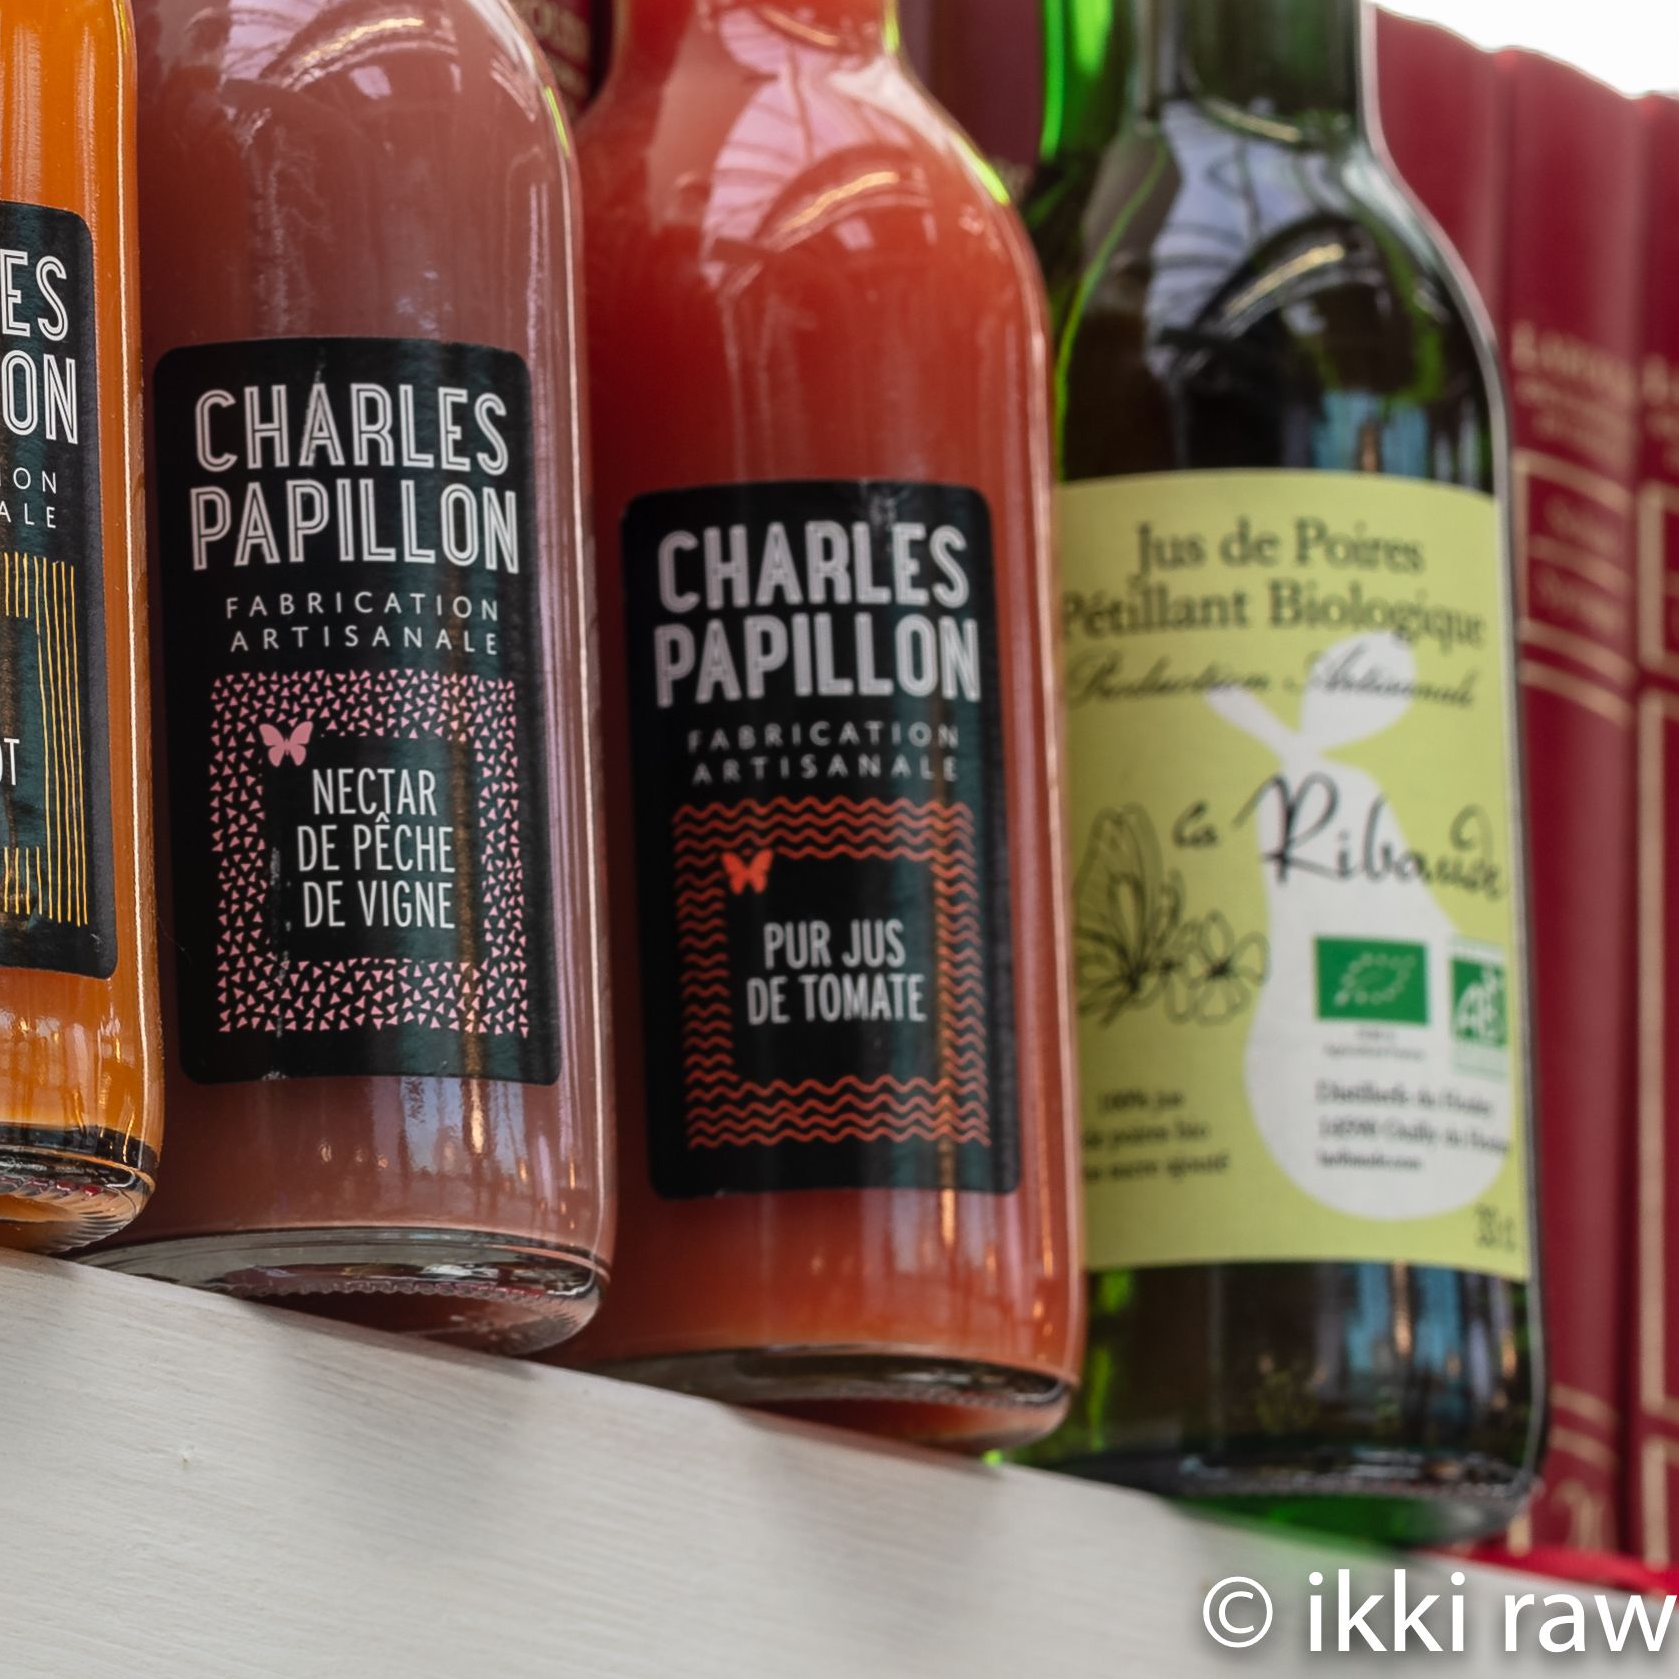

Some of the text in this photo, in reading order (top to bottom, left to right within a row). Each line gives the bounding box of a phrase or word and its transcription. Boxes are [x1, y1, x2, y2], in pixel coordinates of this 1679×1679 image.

[195, 383, 509, 476] CHARLES
[190, 478, 519, 574] PAPILLON
[1134, 516, 1425, 578] Jus de Poires
[658, 520, 969, 613] CHARLES
[225, 591, 499, 622] FABRICATION
[230, 625, 498, 656] ARTISANALE
[653, 612, 981, 709] PAPILLON
[687, 721, 960, 754] FABRICATION
[312, 768, 438, 817] NECTAR
[691, 753, 959, 786] ARTISANALE
[297, 811, 456, 873] DE PÊCHE
[303, 881, 456, 929] DE VIGNE
[763, 918, 906, 970] PUR JUS
[746, 973, 927, 1025] DE TOMATE
